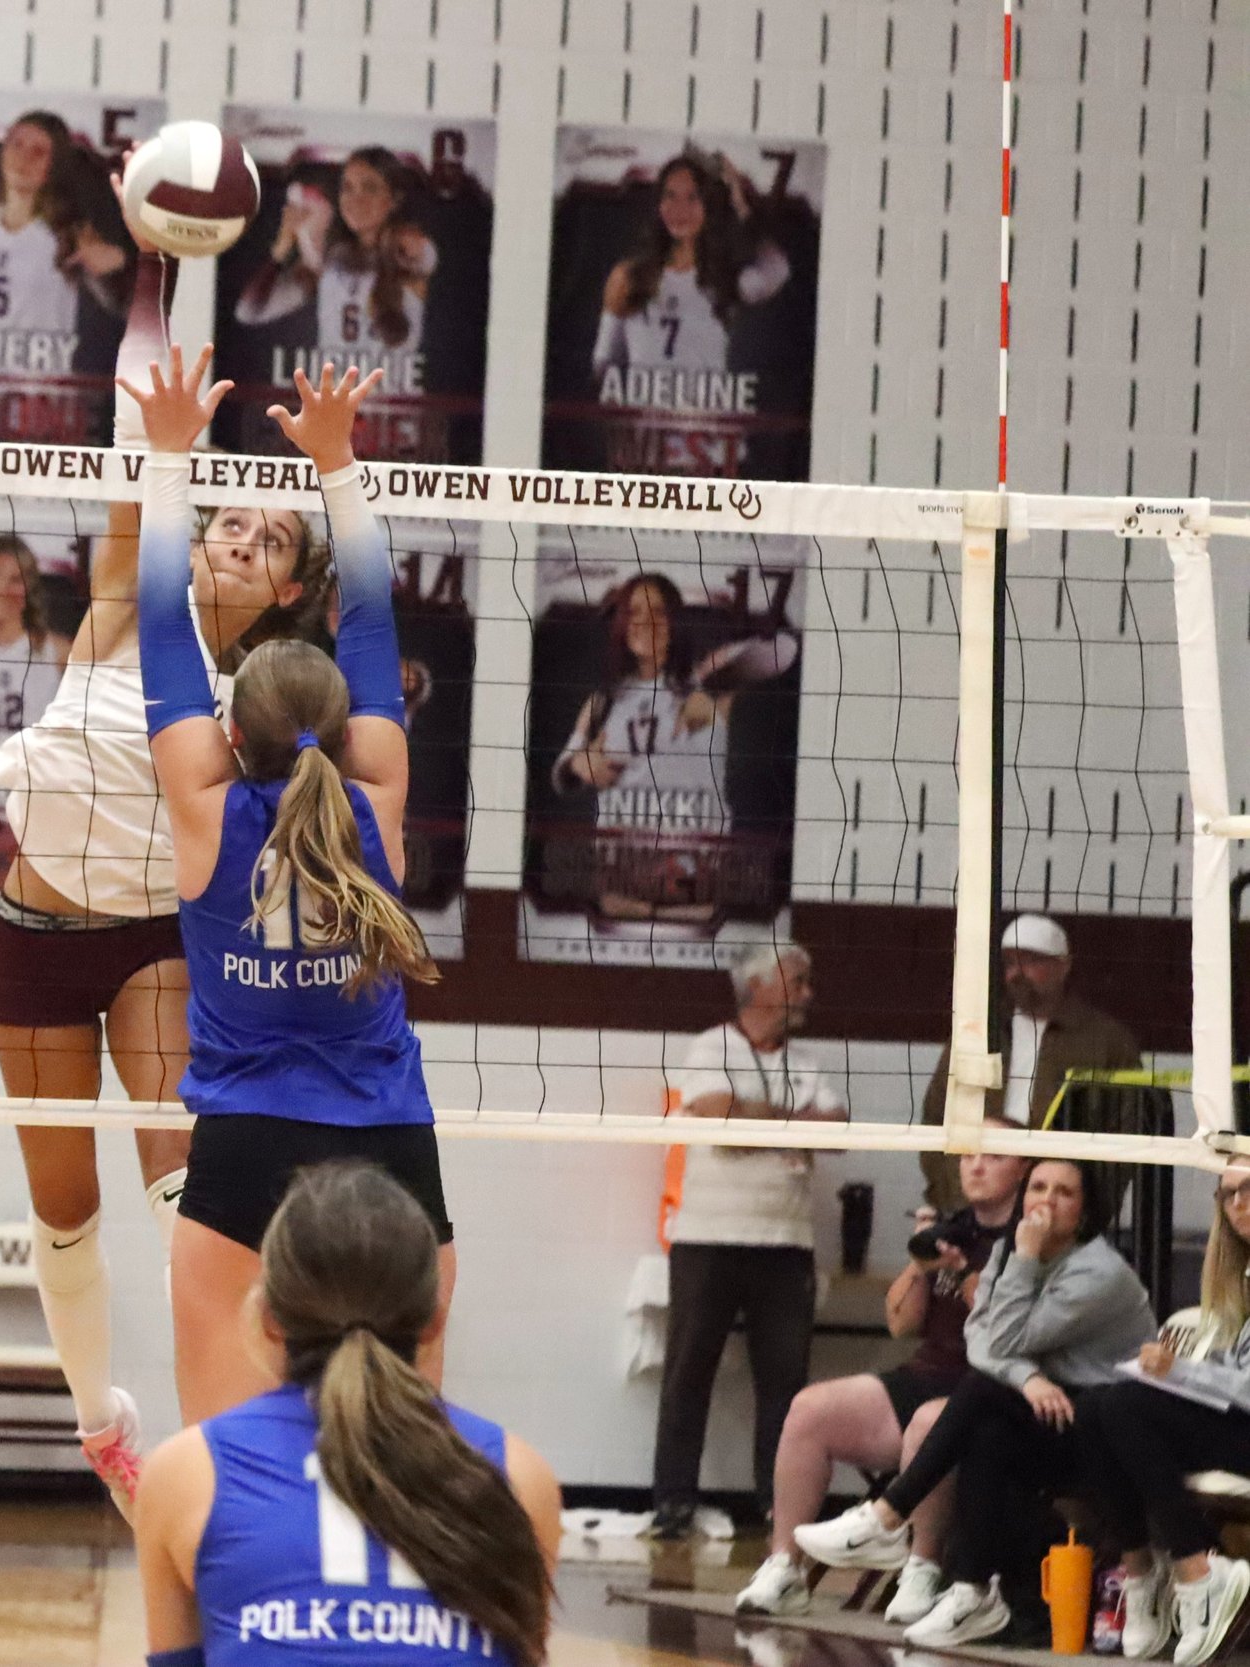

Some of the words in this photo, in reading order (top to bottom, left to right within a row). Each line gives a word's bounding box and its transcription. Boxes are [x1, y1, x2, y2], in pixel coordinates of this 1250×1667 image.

[659, 316, 680, 359] 7
[600, 365, 759, 414] ADELINE
[2, 448, 104, 479] OWEN
[123, 454, 319, 491] VLEYBAL
[389, 469, 491, 500] OWEN
[509, 474, 723, 511] VOLLEYBALL
[627, 716, 659, 756] 17
[224, 953, 288, 988] POLK
[296, 955, 361, 988] COUN
[239, 1599, 339, 1643] POLK
